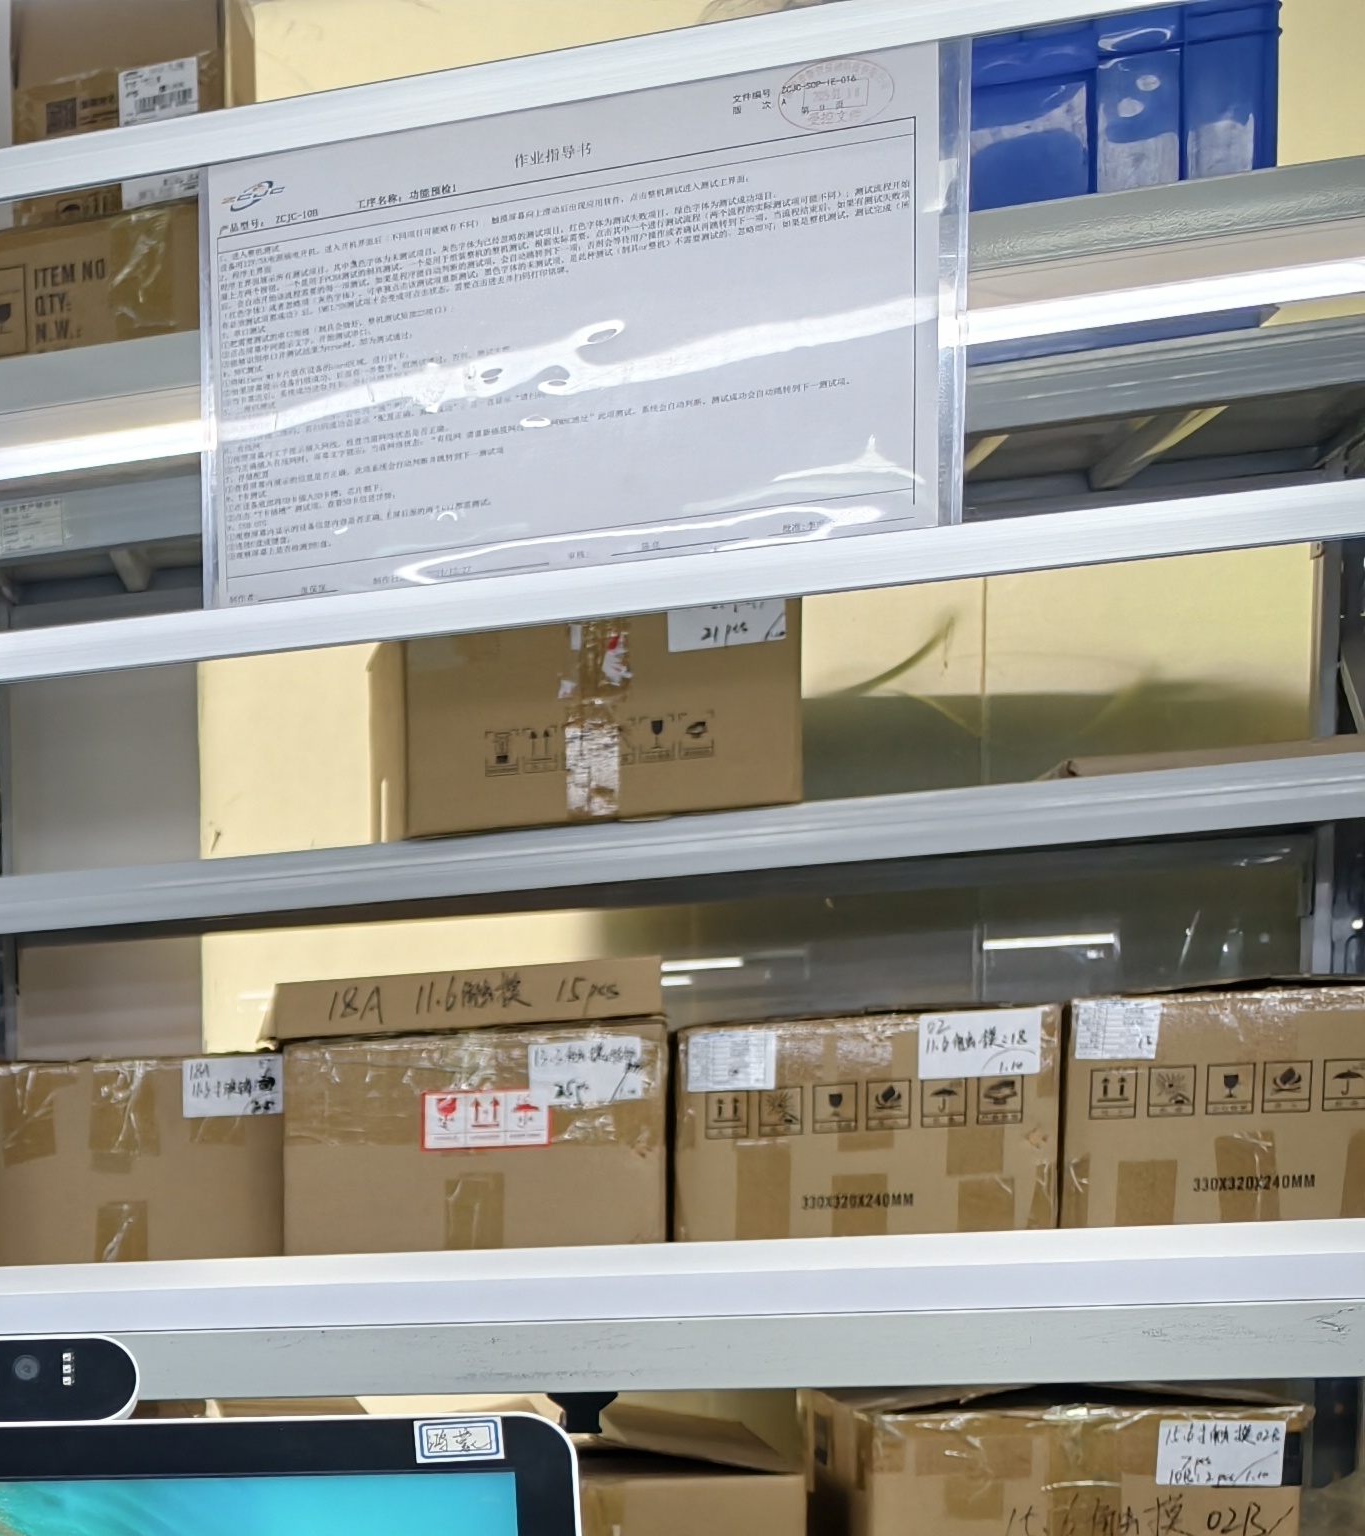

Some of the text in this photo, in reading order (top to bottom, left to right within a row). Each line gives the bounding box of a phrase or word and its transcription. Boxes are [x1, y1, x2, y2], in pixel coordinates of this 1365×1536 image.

[732, 88, 771, 104] 文件编号
[514, 142, 592, 169] 作业指导书
[34, 266, 75, 292] ITEM
[328, 985, 384, 1025] 18A
[1192, 1173, 1316, 1193] 330X320X240MM
[800, 1191, 915, 1211] 330X320X240MM
